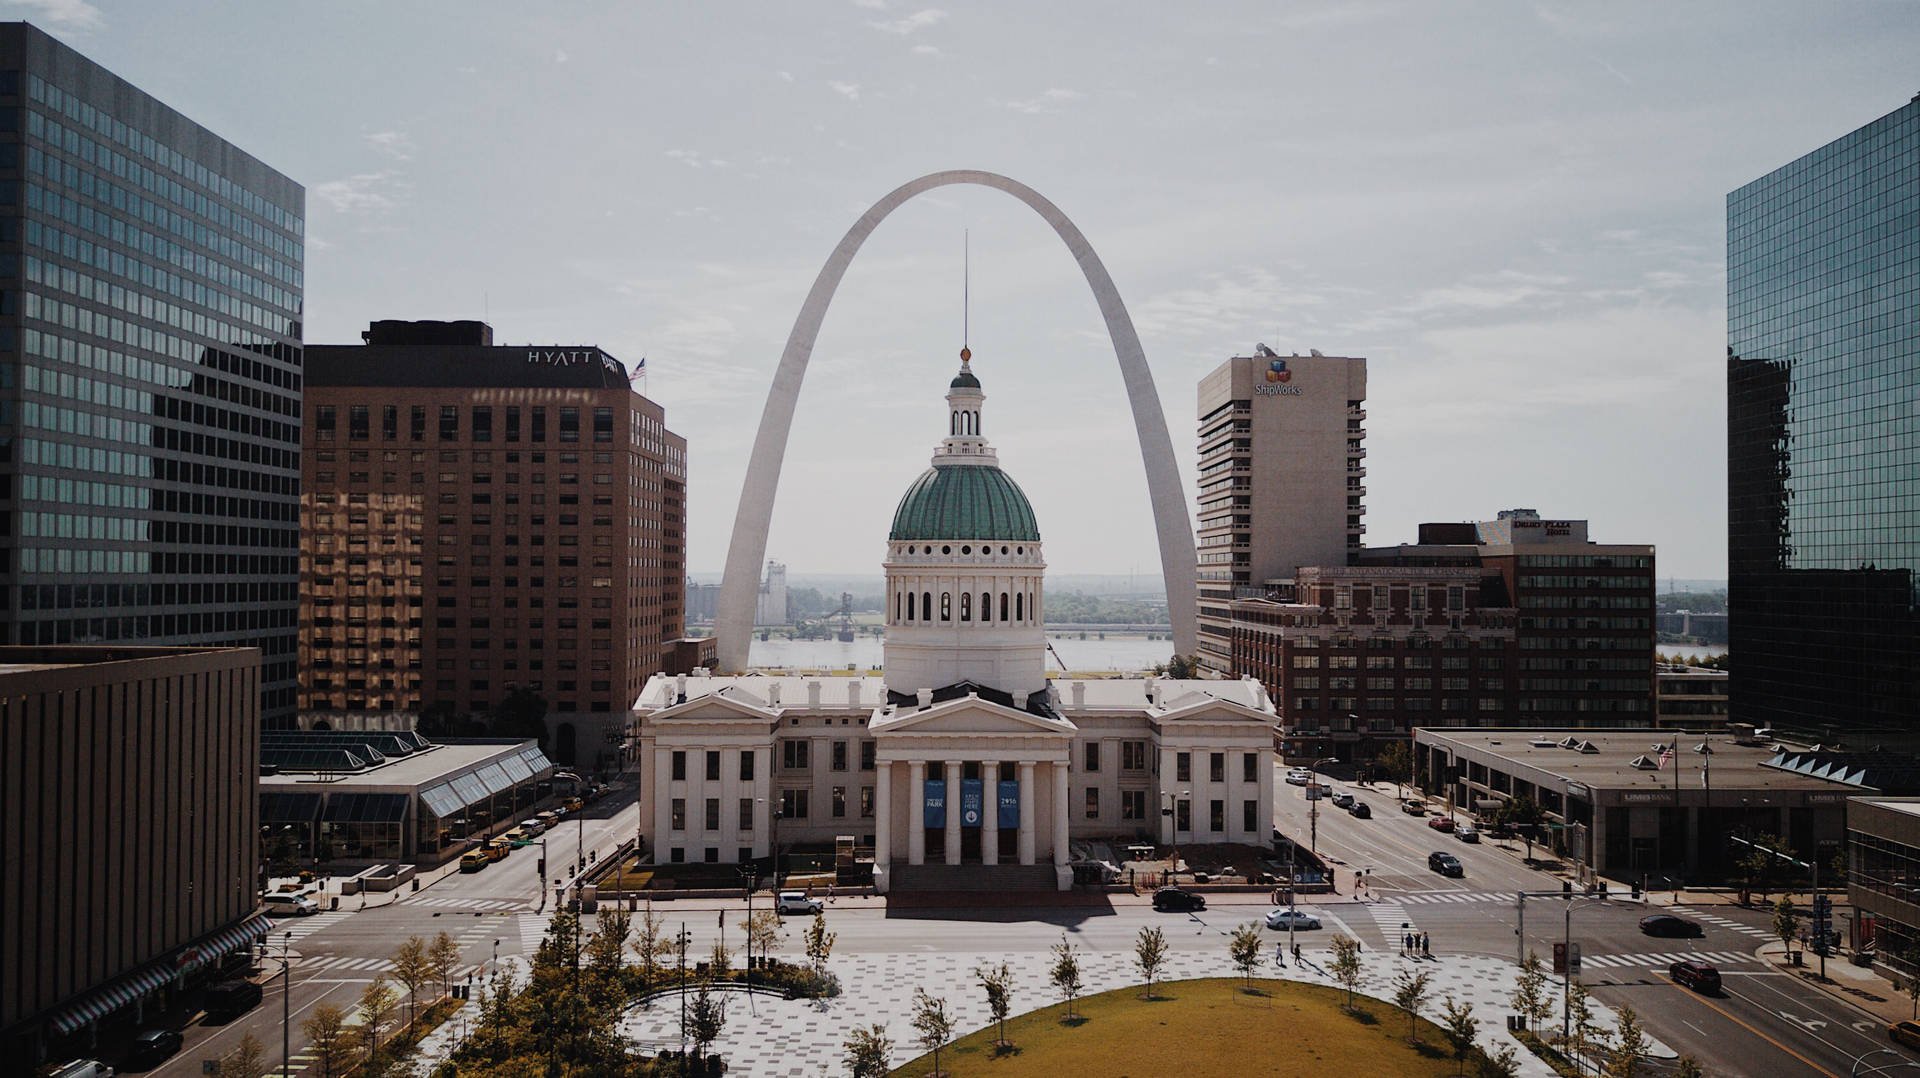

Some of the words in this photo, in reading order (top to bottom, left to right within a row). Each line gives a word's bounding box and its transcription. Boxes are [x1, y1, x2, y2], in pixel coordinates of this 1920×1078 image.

[528, 351, 593, 366] HYATT
[1255, 384, 1303, 396] ShipWorks
[927, 800, 943, 808] PARK
